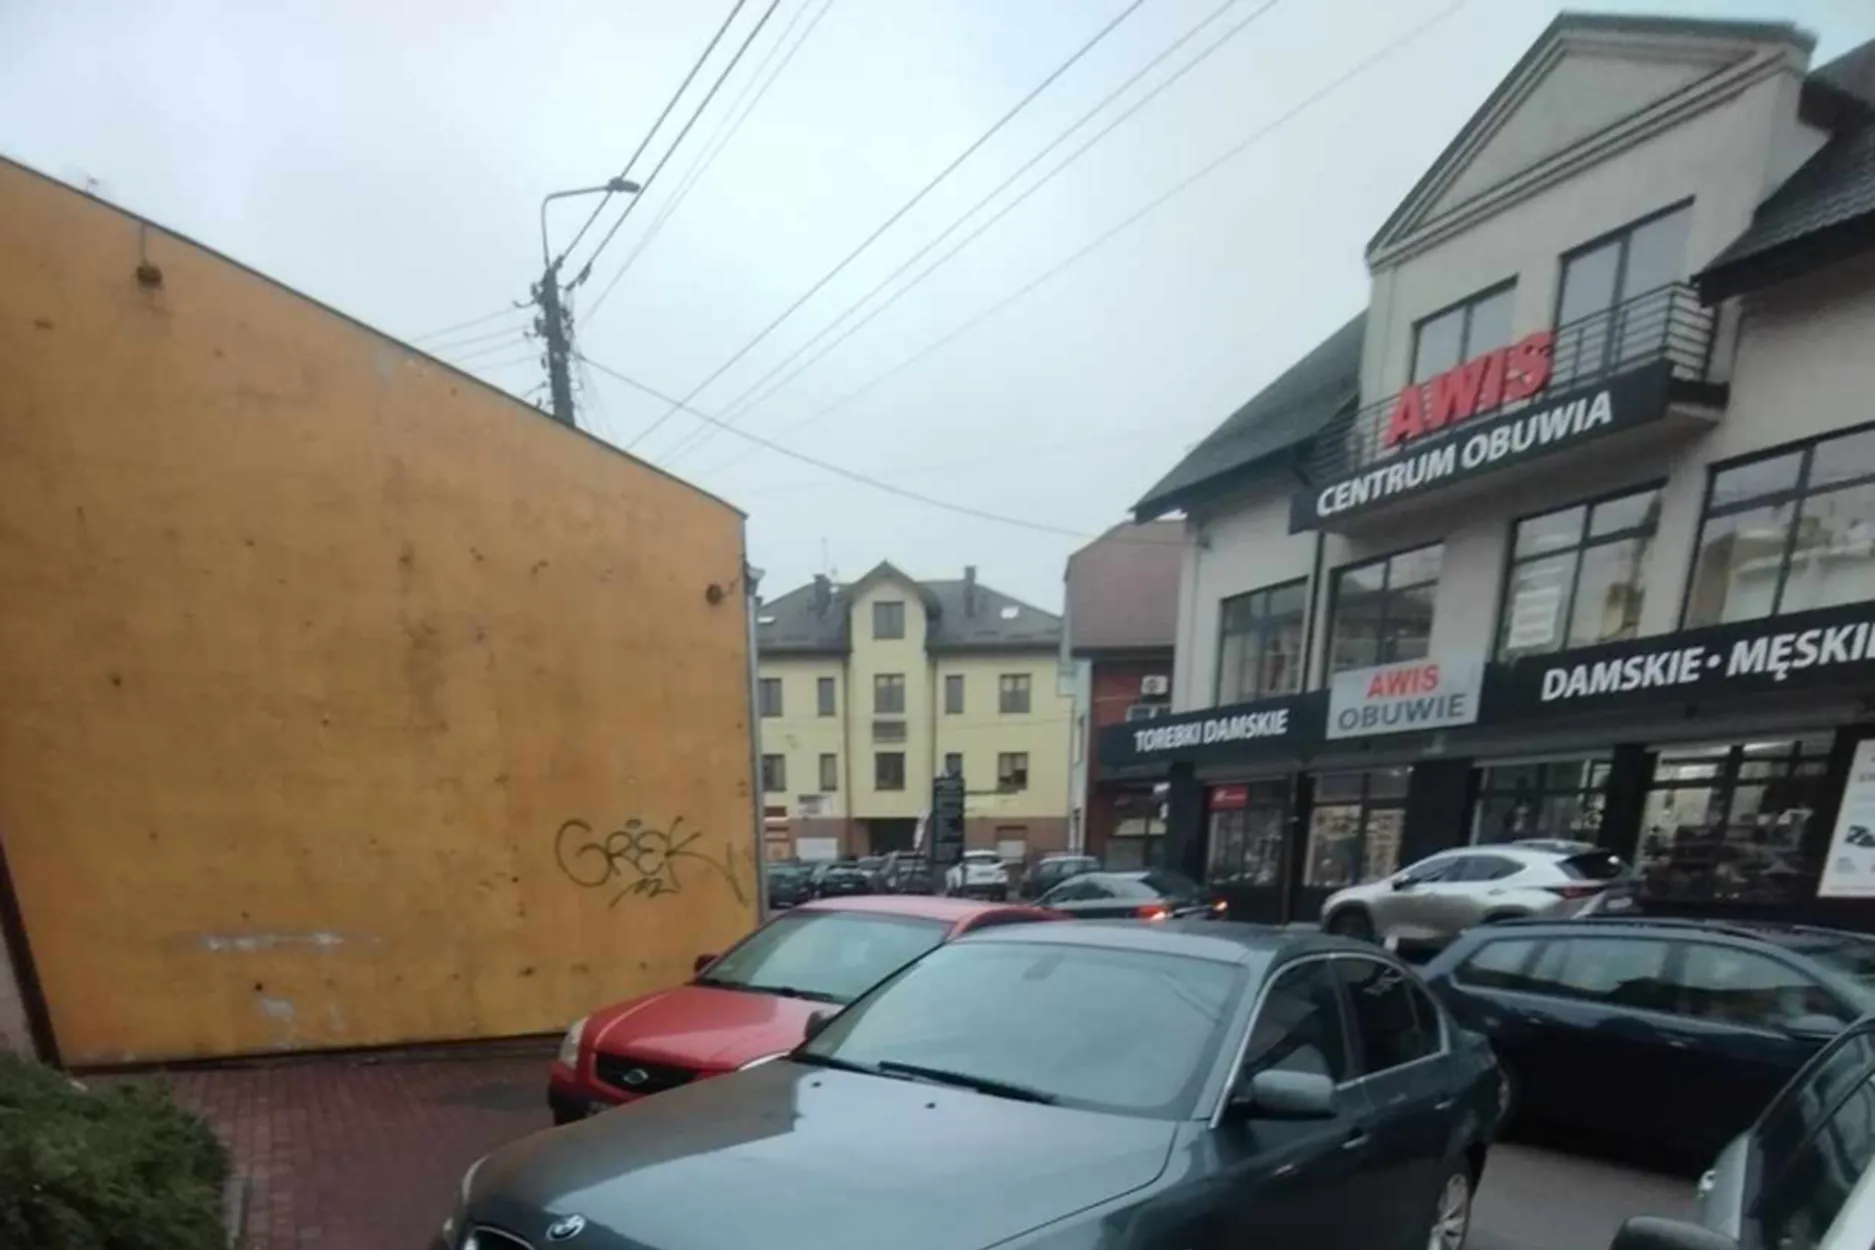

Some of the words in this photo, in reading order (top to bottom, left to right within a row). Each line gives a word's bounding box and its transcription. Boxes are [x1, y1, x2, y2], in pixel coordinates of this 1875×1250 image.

[1384, 329, 1558, 448] AWIS
[1316, 446, 1457, 517] CENTRUM
[1461, 390, 1613, 469] OBUWIA
[1366, 664, 1441, 700] AWIS
[1540, 646, 1706, 702] DAMSKIE
[1134, 721, 1203, 753] TOREBKI
[1203, 708, 1290, 744] DAMSKIE
[1338, 693, 1468, 732] OBUWIE
